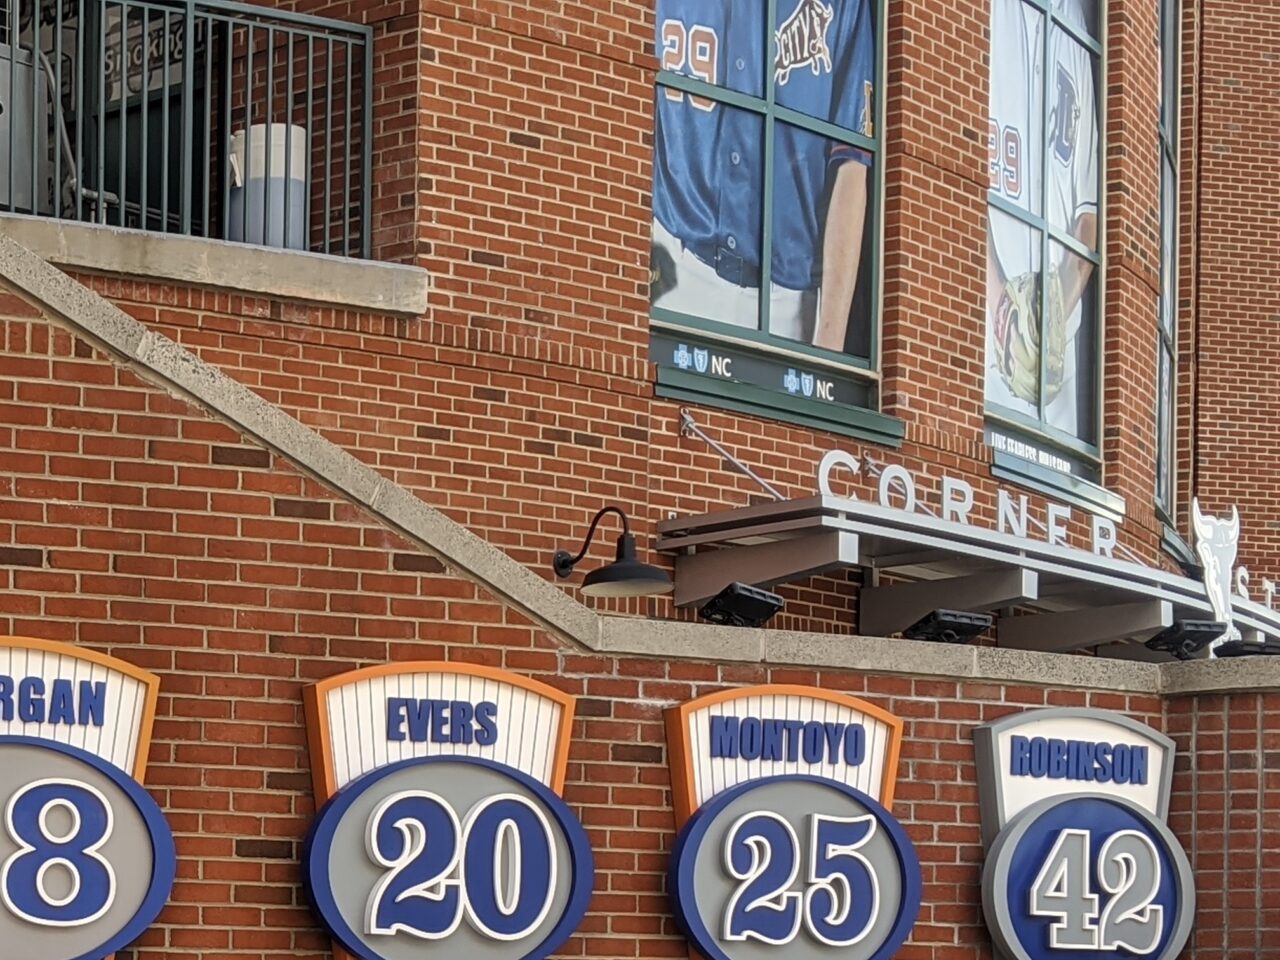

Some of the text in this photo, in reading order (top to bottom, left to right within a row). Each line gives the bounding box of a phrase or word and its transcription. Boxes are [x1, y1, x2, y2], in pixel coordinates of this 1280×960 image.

[662, 19, 718, 112] 29
[780, 3, 811, 68] CITY
[988, 117, 1021, 200] 29
[711, 355, 732, 377] NC
[816, 379, 835, 401] NC
[818, 449, 1116, 558] CORNER
[387, 697, 498, 746] EVERS
[710, 715, 866, 767] MONTOYO
[1010, 735, 1149, 785] ROBINSON
[364, 789, 558, 941] 20
[723, 810, 880, 947] 25
[1030, 828, 1163, 955] 42
